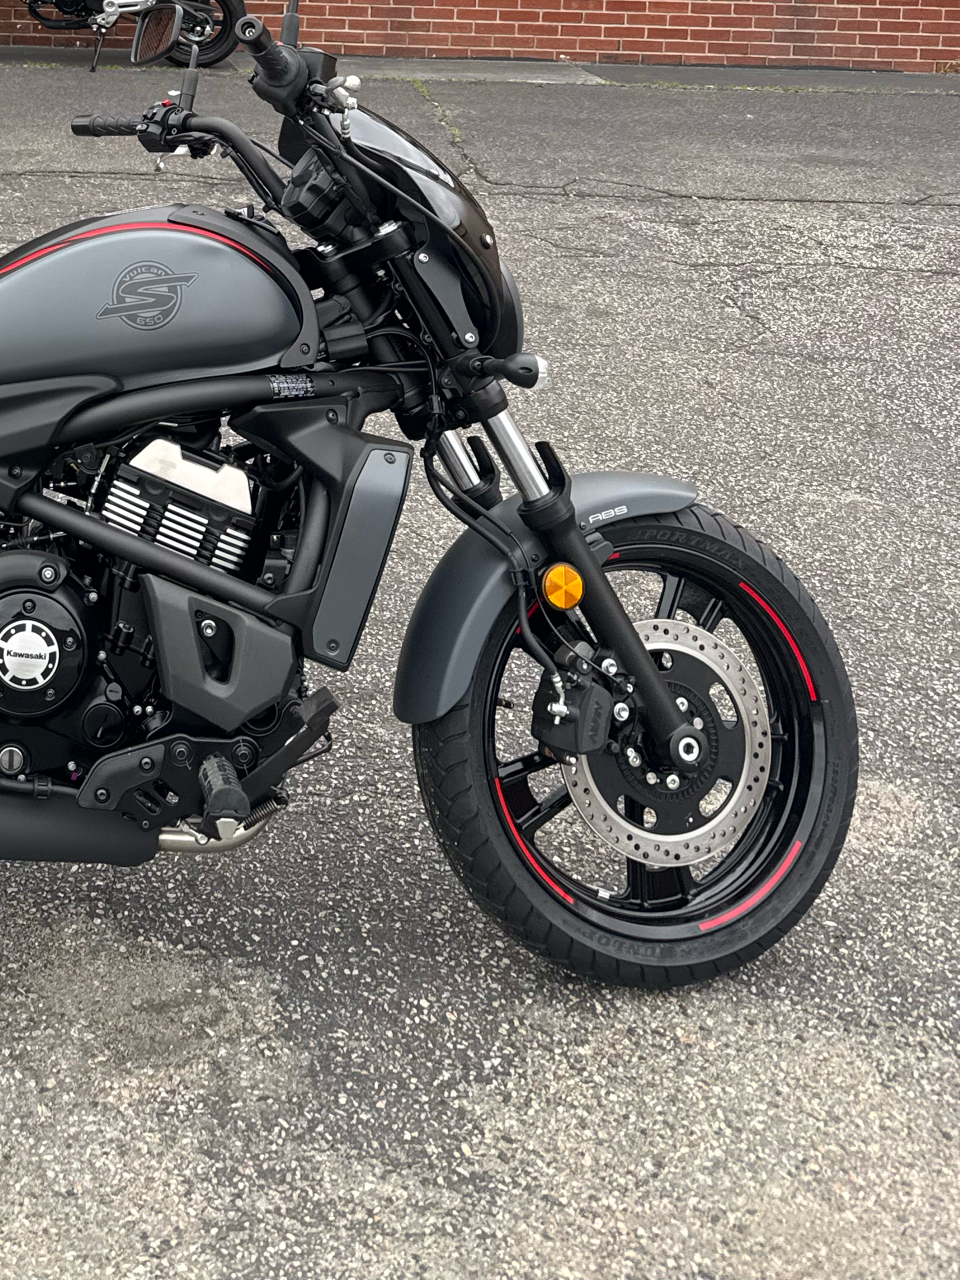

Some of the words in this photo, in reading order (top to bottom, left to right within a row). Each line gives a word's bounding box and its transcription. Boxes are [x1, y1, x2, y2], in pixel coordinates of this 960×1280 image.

[136, 314, 164, 326] 650
[589, 505, 628, 524] ABS
[6, 649, 47, 661] Kawasaki
